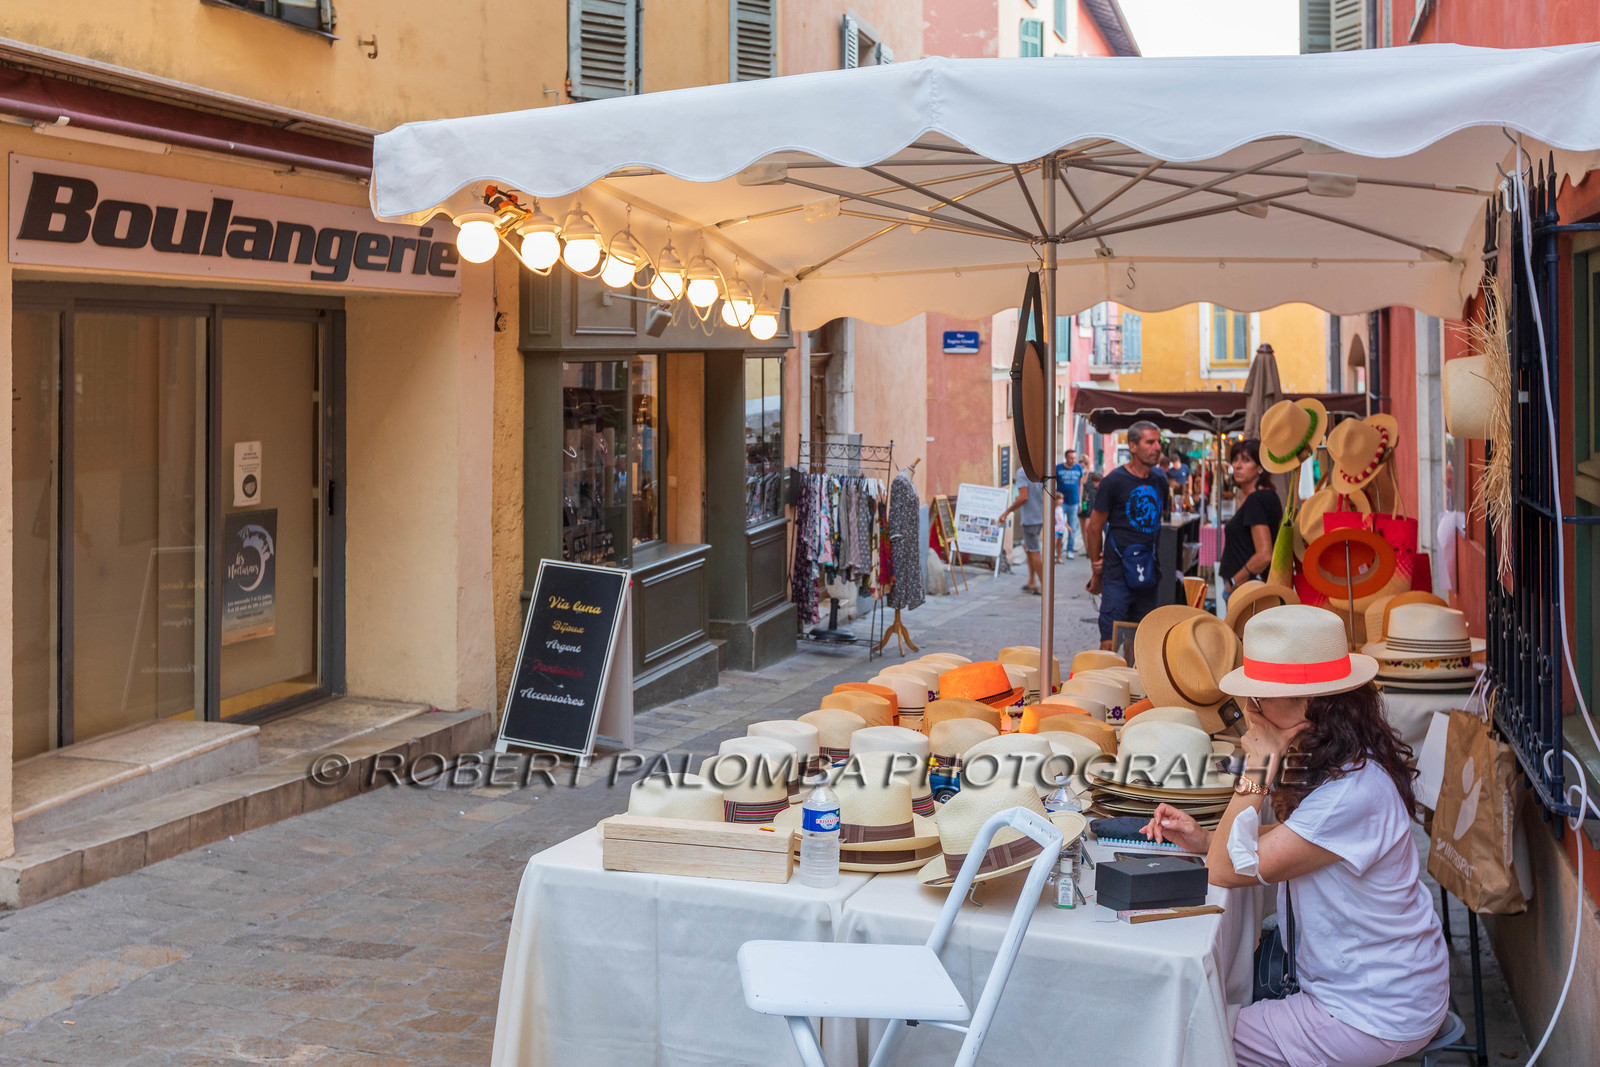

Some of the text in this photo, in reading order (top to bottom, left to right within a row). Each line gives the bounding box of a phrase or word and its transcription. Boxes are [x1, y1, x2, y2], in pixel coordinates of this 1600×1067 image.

[16, 171, 459, 282] Boulangerie
[548, 595, 602, 615] Via luna
[551, 620, 585, 634] Bijoux
[545, 639, 582, 654] Argent
[520, 687, 586, 707] Accessoires
